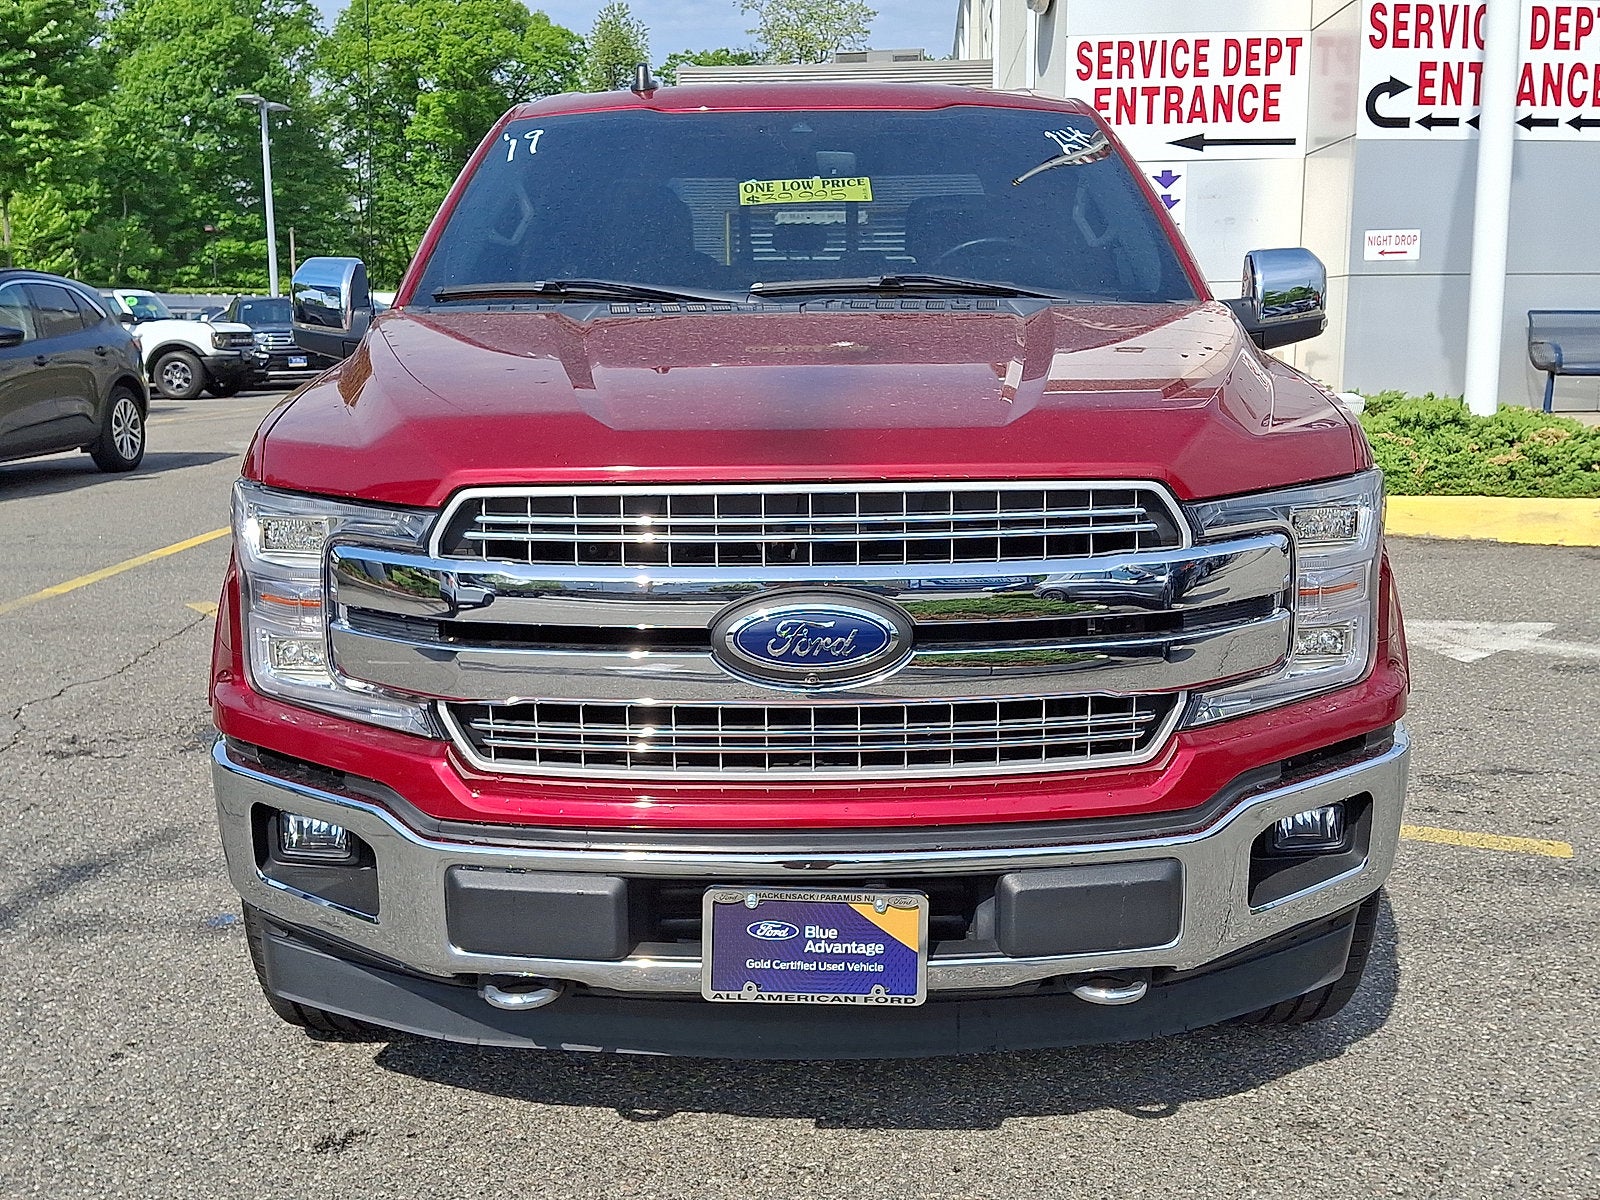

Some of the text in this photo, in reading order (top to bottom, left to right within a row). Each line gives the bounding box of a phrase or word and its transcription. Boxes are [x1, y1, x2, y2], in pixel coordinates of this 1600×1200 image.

[1368, 2, 1600, 51] SERVIC DEP
[1076, 39, 1210, 81] SERVICE
[1223, 37, 1303, 77] DEPT
[1094, 83, 1282, 126] ENTRANCE
[743, 178, 866, 193] ONE LOW PRICE
[1367, 234, 1418, 246] NIGHT DROP
[767, 619, 859, 657] Ford
[756, 922, 789, 938] Ford
[804, 925, 838, 939] Blue
[803, 940, 885, 957] Advantage
[745, 959, 884, 972] Gold Certified Used Vehicle
[712, 992, 917, 1005] ALL AMERICAN FORD
